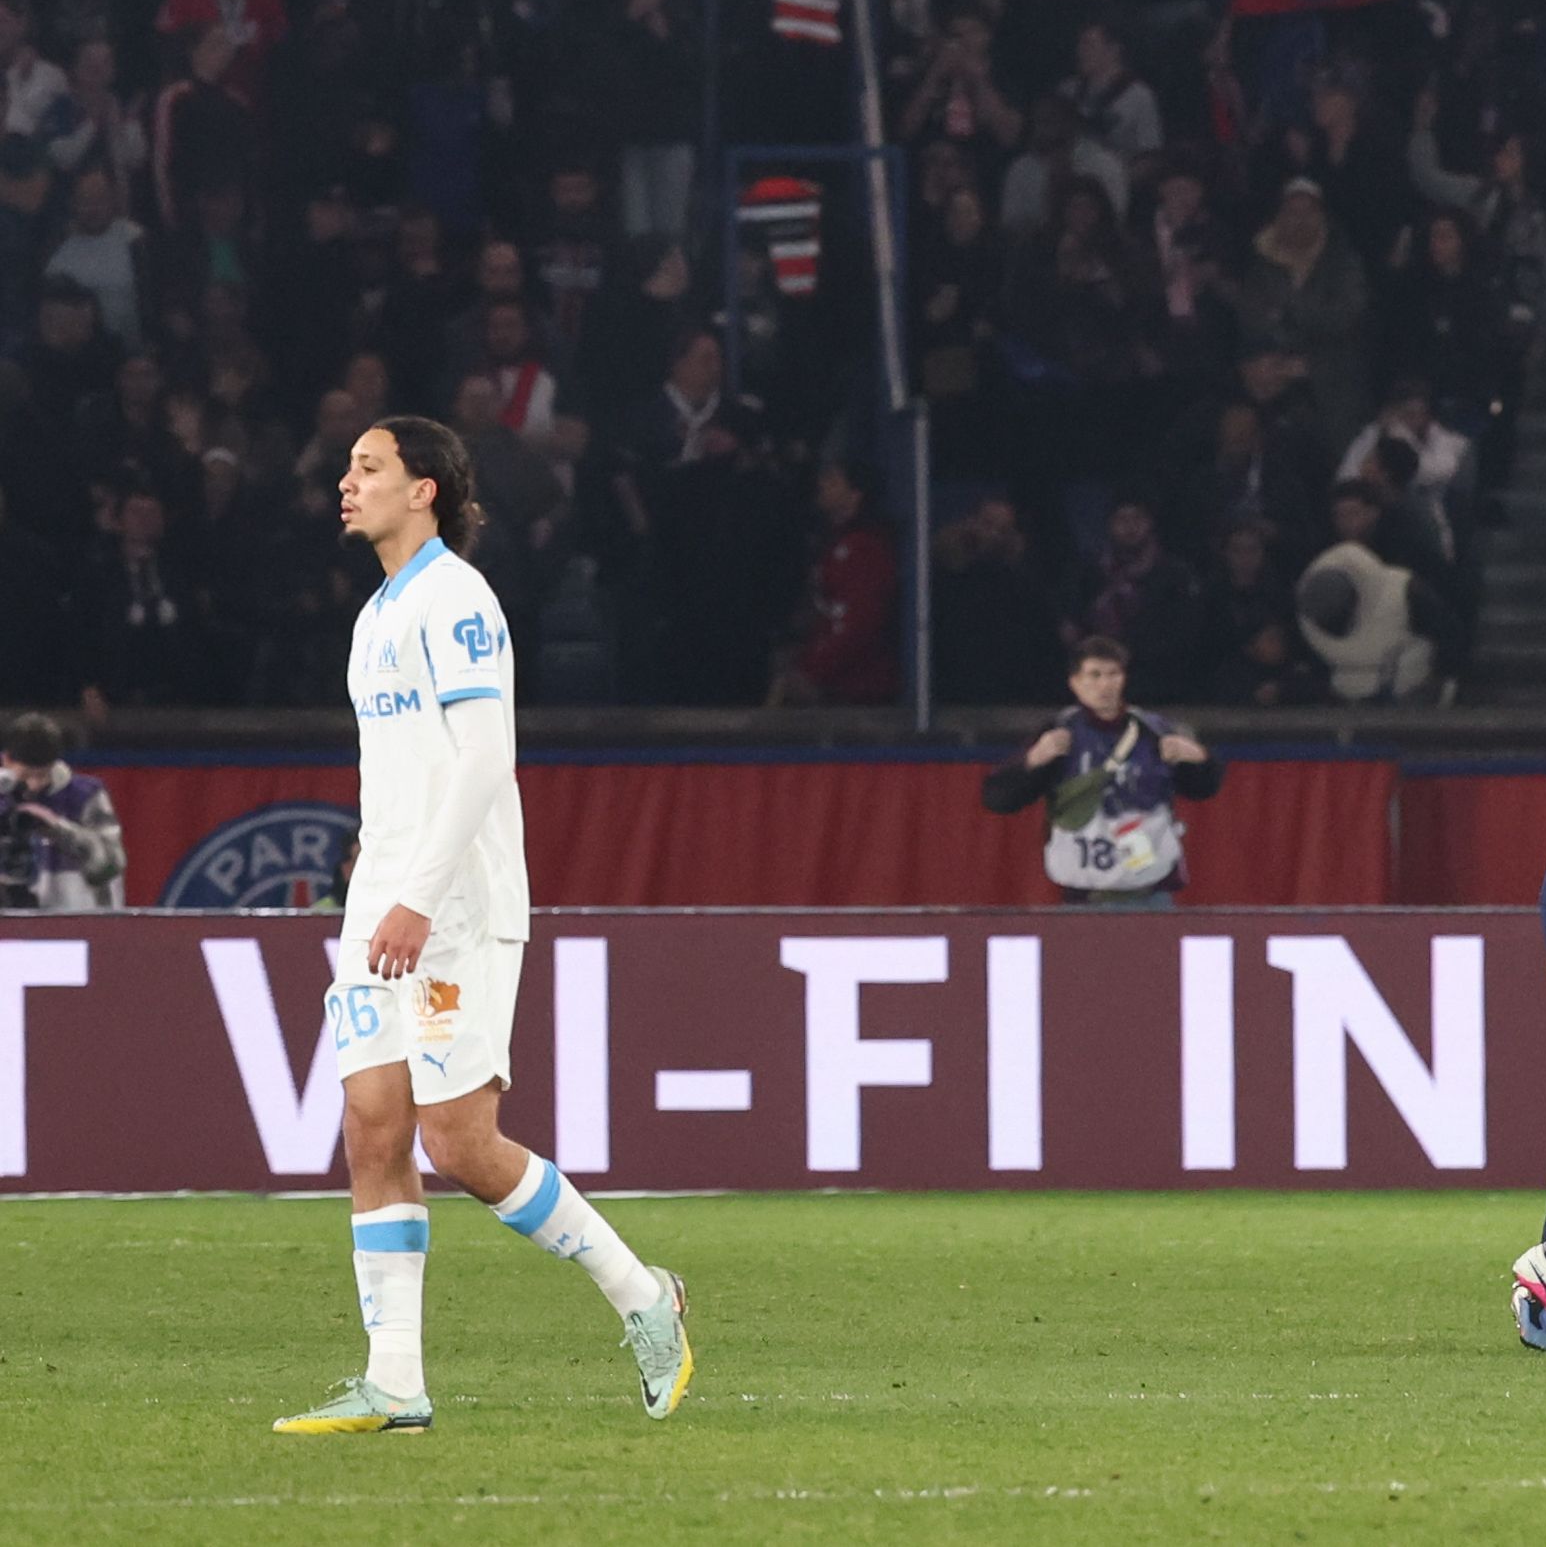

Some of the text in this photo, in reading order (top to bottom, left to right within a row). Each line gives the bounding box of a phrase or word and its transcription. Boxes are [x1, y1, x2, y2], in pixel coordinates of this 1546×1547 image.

[205, 824, 331, 897] PAR
[328, 985, 380, 1051] 26
[1181, 937, 1486, 1170] IN
